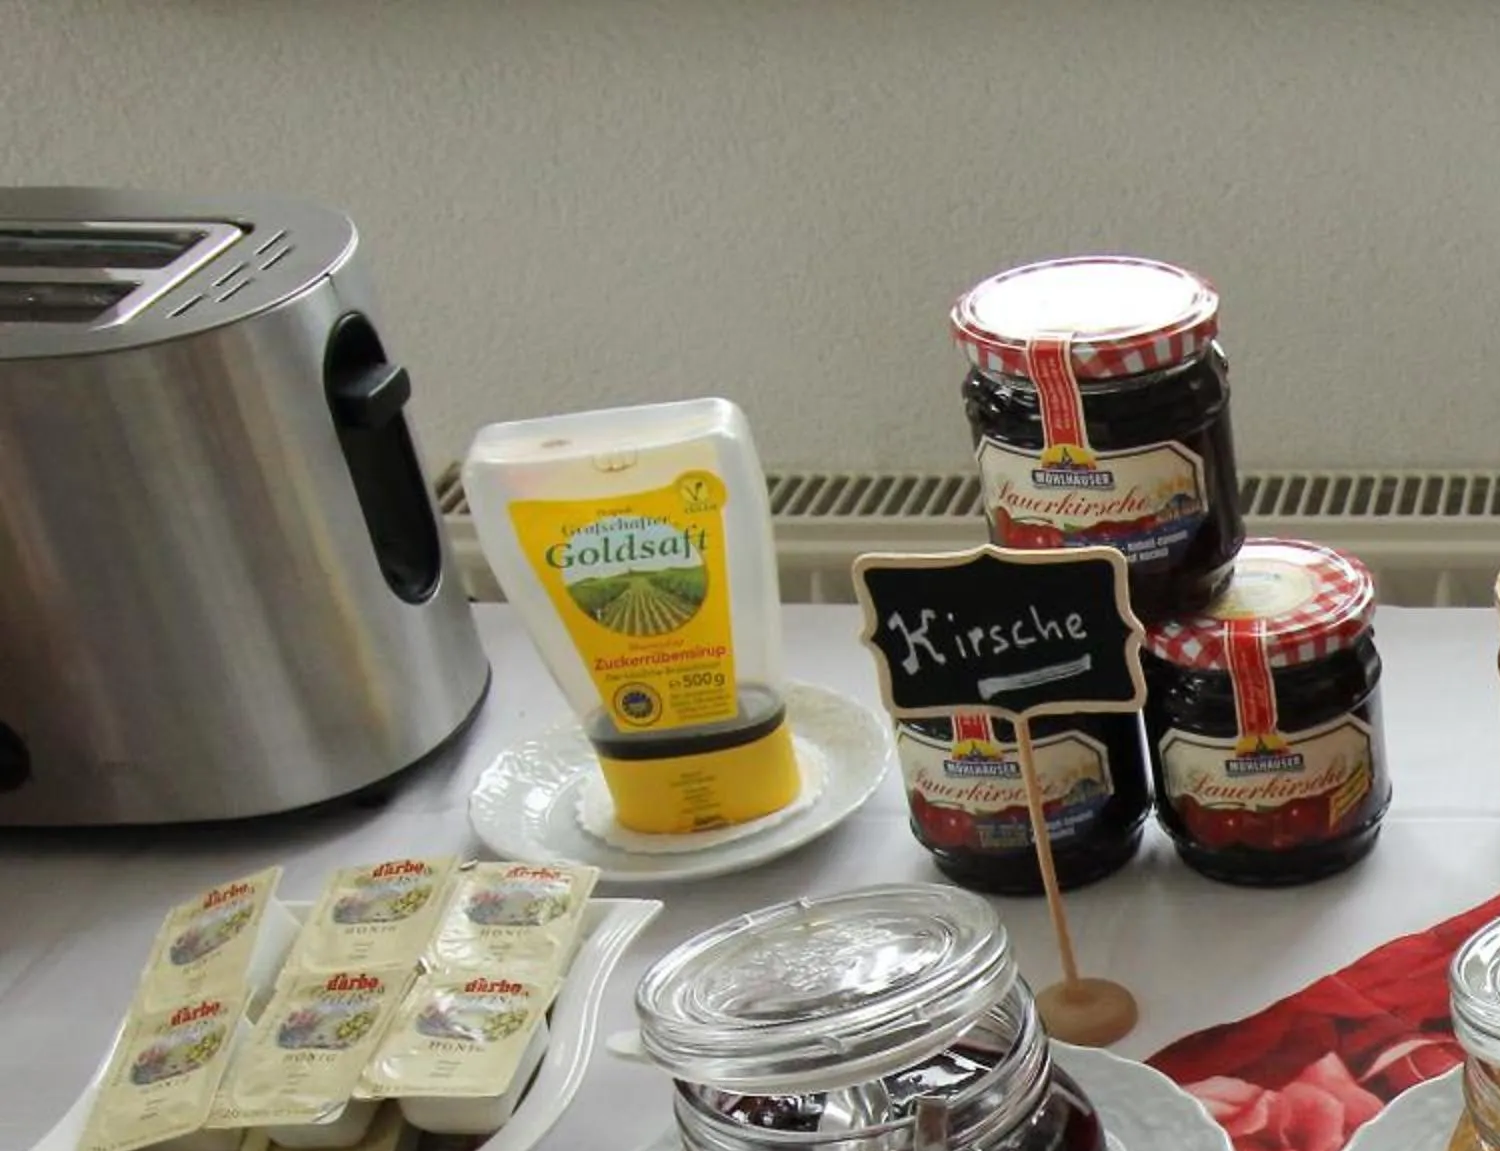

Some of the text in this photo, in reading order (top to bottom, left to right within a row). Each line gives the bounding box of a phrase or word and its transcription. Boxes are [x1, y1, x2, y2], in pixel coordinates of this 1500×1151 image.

[545, 523, 709, 569] Goldsaft
[887, 605, 1088, 676] Kirsche
[683, 672, 713, 688] 500
